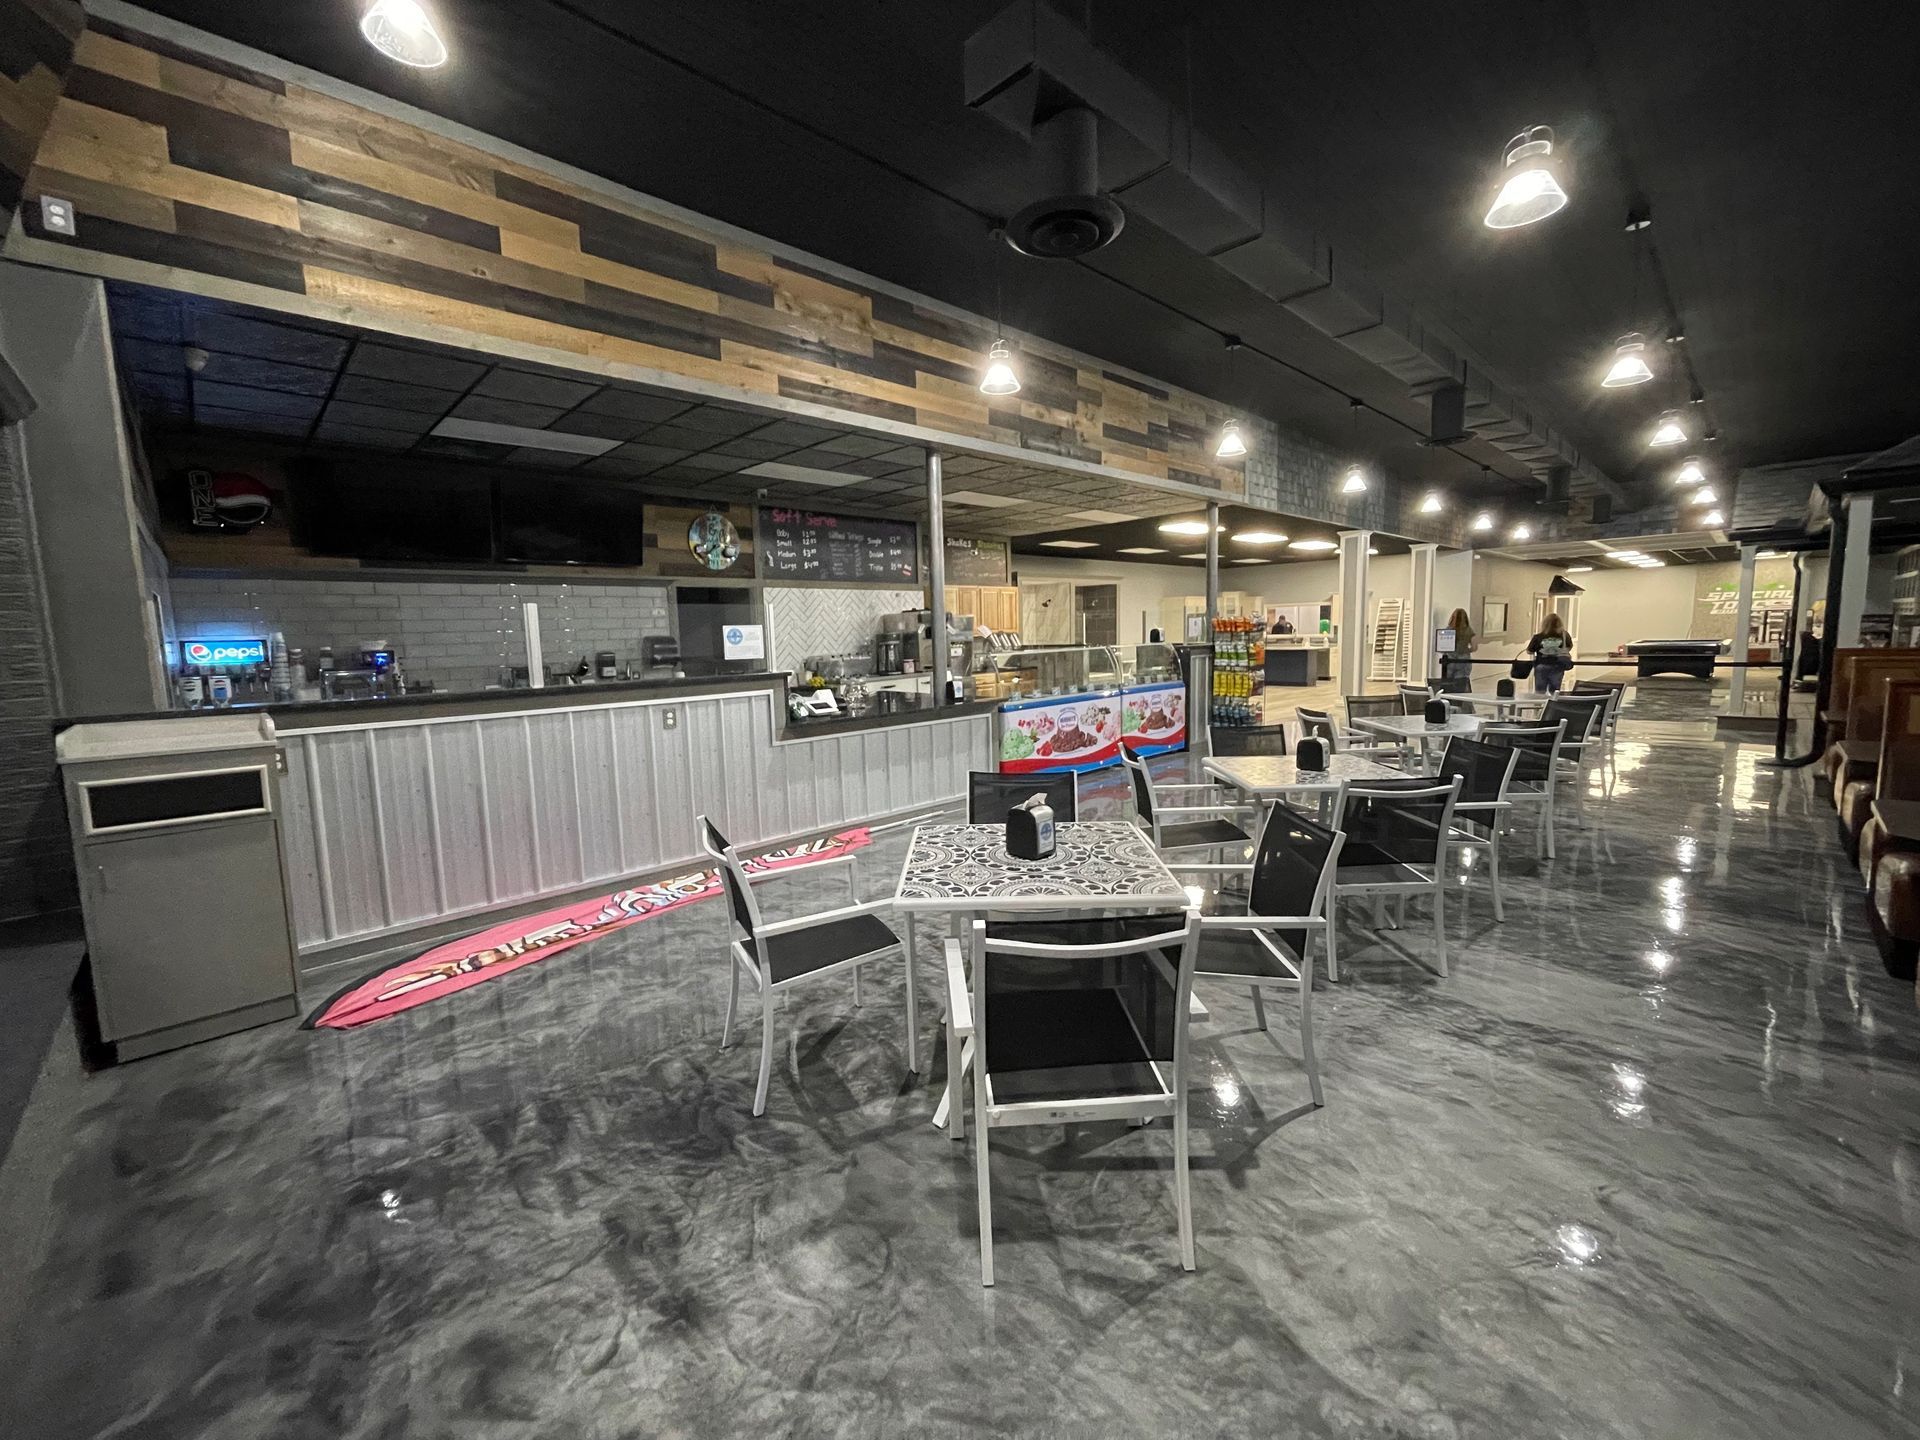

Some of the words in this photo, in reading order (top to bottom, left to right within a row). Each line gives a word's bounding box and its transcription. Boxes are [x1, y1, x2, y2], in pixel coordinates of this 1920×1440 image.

[771, 508, 801, 524] Soft
[806, 512, 837, 528] Serve
[776, 539, 793, 547] Small
[780, 561, 797, 571] Large
[1706, 590, 1794, 601] SPCIAL
[213, 644, 264, 661] pepsi
